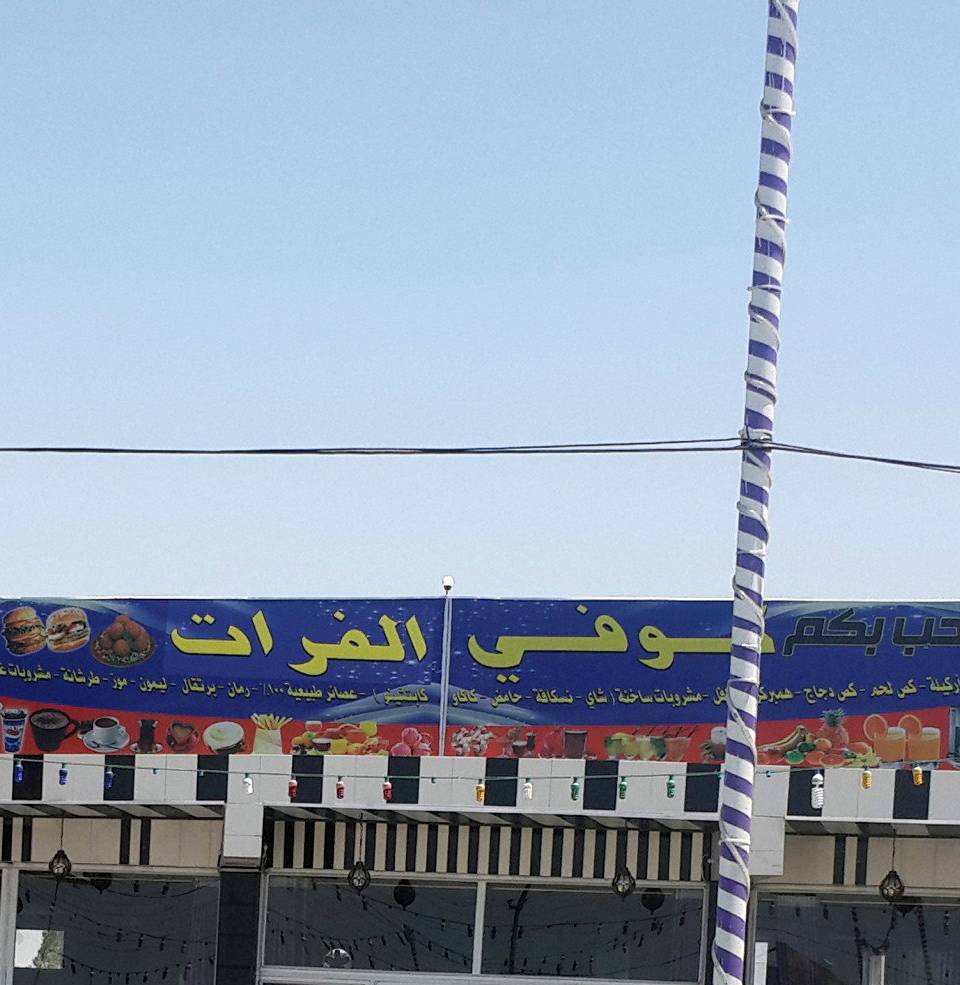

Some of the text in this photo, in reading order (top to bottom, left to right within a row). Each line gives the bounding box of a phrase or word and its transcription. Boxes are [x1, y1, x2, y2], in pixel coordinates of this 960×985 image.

[170, 609, 428, 677] الفرات
[781, 607, 886, 657] بكم
[892, 616, 960, 657] حب
[109, 672, 128, 691] موز
[139, 676, 168, 694] ليمون
[181, 676, 218, 698] برتقال
[227, 680, 251, 699] رمان
